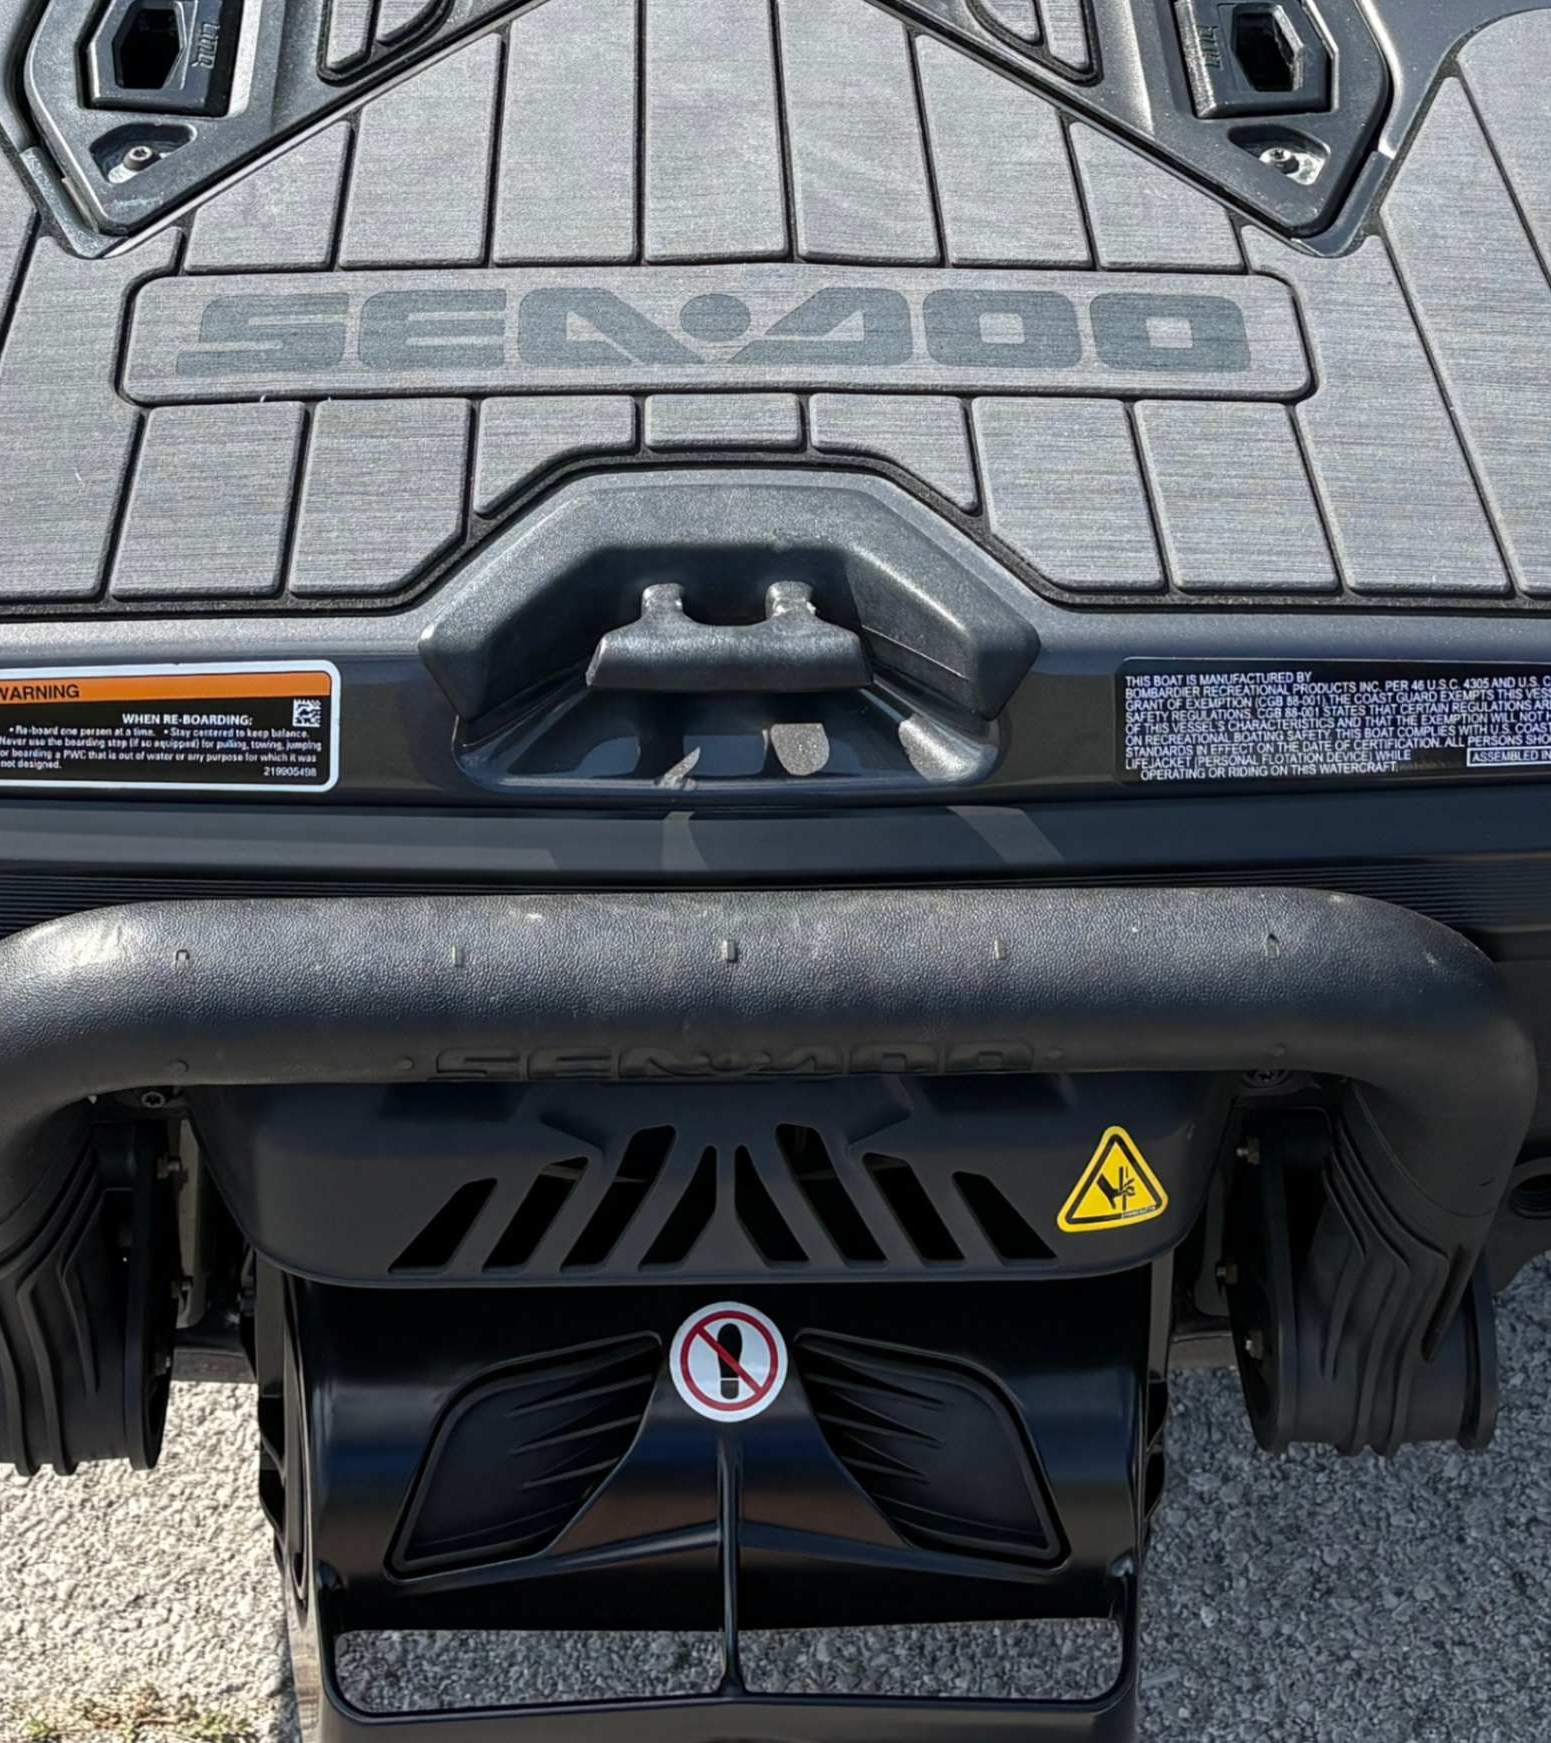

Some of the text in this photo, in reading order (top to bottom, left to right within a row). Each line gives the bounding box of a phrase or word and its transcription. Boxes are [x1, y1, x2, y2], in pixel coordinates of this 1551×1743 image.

[1126, 672, 1311, 686] THIS BOAT IS MANUFACTURED BY
[1126, 685, 1200, 698] BOMBARDIER
[1202, 683, 1289, 696] RECREATIONAL
[1292, 681, 1356, 693] PRODUCTS
[1384, 679, 1408, 690] PER
[1462, 677, 1488, 688] 4305
[1491, 676, 1515, 687] AND
[1126, 698, 1164, 710] GRANT
[1167, 698, 1182, 709] OF
[1185, 696, 1252, 709] EXEMPTION
[1329, 693, 1350, 704] THE
[1353, 691, 1393, 703] COAST
[1396, 690, 1437, 702] GUARD
[1440, 688, 1494, 701] EXEMPTS
[1497, 688, 1522, 699] THIS
[122, 714, 253, 725] WHEN RE-BOARDING:
[1126, 711, 1168, 723] SAFETY
[1256, 707, 1281, 719] CGB
[1322, 705, 1365, 717] STATES
[1368, 704, 1397, 715] THAT
[1400, 702, 1449, 714] CERTAIN
[1451, 700, 1531, 713] REGULATIONS
[1126, 724, 1141, 735] OF
[1144, 723, 1169, 734] THIS
[1228, 717, 1334, 731] CHARACTERISTICS
[1337, 717, 1361, 728] AND
[1364, 716, 1393, 727] THAT
[1395, 715, 1417, 726] THE
[1420, 713, 1487, 725] EXEMPTION
[1490, 712, 1516, 723] WILL
[1519, 711, 1543, 722] NOT
[1126, 735, 1142, 746] ON
[1145, 732, 1230, 745] RECREATIONAL
[1233, 731, 1283, 742] BOATING
[1335, 728, 1361, 739] THIS
[1364, 727, 1393, 738] BOAT
[1396, 726, 1455, 737] COMPLIES
[1458, 725, 1487, 736] WITH
[1126, 745, 1193, 757] STANDARDS
[1196, 744, 1207, 755] IN
[1210, 743, 1253, 755] EFFECT
[1256, 742, 1274, 753] ON
[1277, 742, 1299, 753] THE
[1302, 741, 1331, 752] DATE
[1334, 740, 1350, 751] OF
[1444, 737, 1464, 748] ALL
[1467, 735, 1522, 747] PERSONS
[1126, 757, 1191, 769] LIFEJACKET
[1261, 753, 1323, 765] FLOTATION
[1375, 750, 1411, 761] WHILE
[1471, 752, 1538, 763] ASSEMBLED
[1541, 750, 1551, 760] IN
[1141, 764, 1316, 781] OPERATING OR RIDING ON THIS
